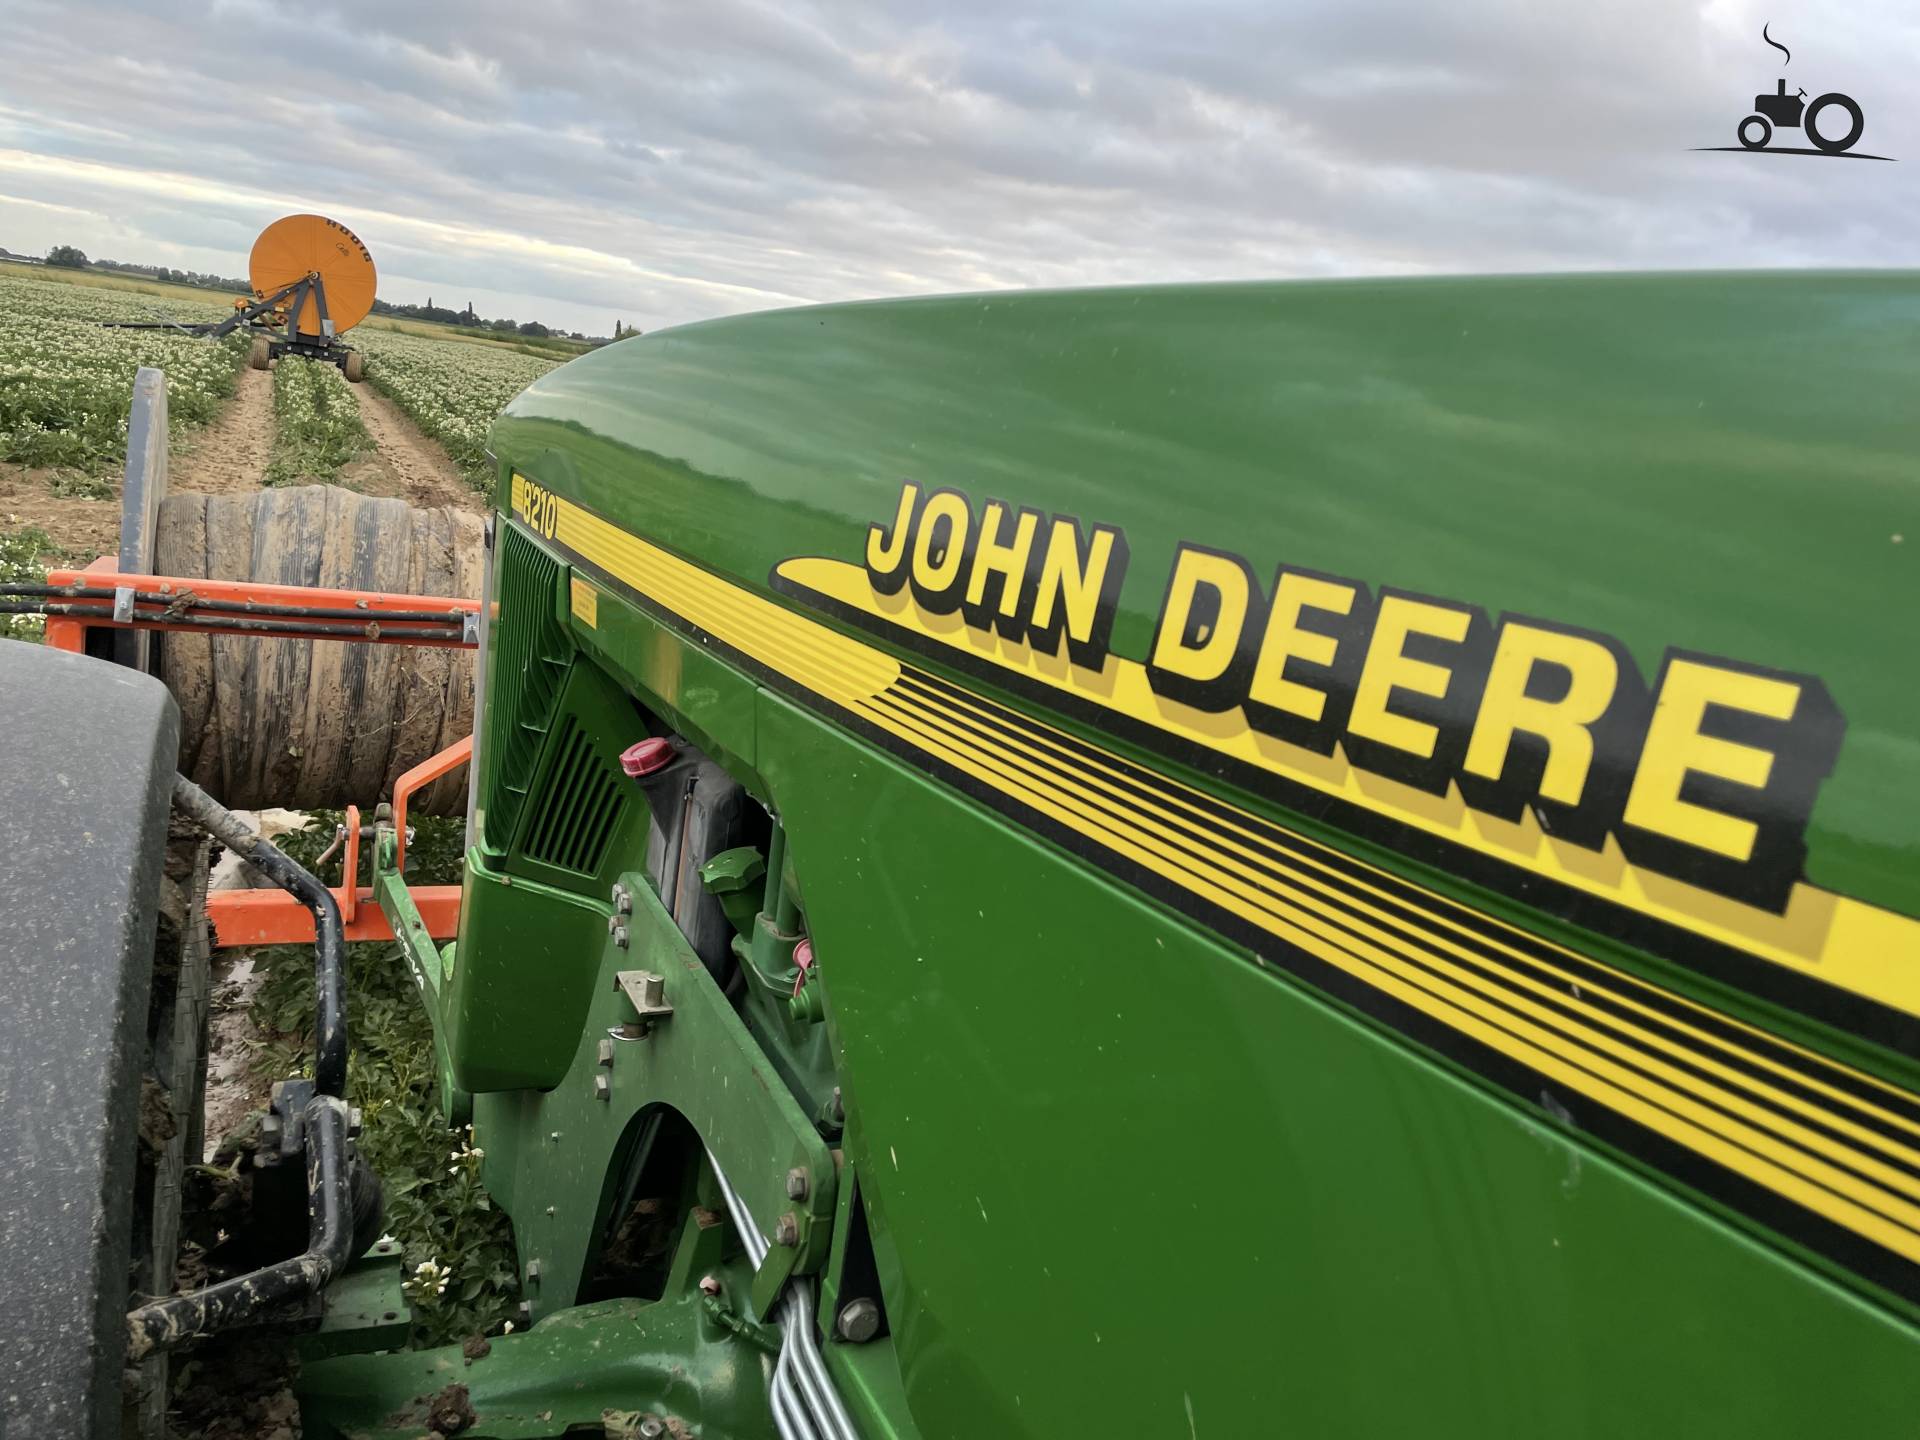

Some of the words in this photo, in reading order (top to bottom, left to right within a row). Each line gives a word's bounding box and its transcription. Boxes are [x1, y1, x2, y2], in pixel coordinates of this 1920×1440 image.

[522, 480, 557, 541] 8210
[865, 482, 1117, 646] JOHN
[1150, 547, 1803, 864] DEERE
